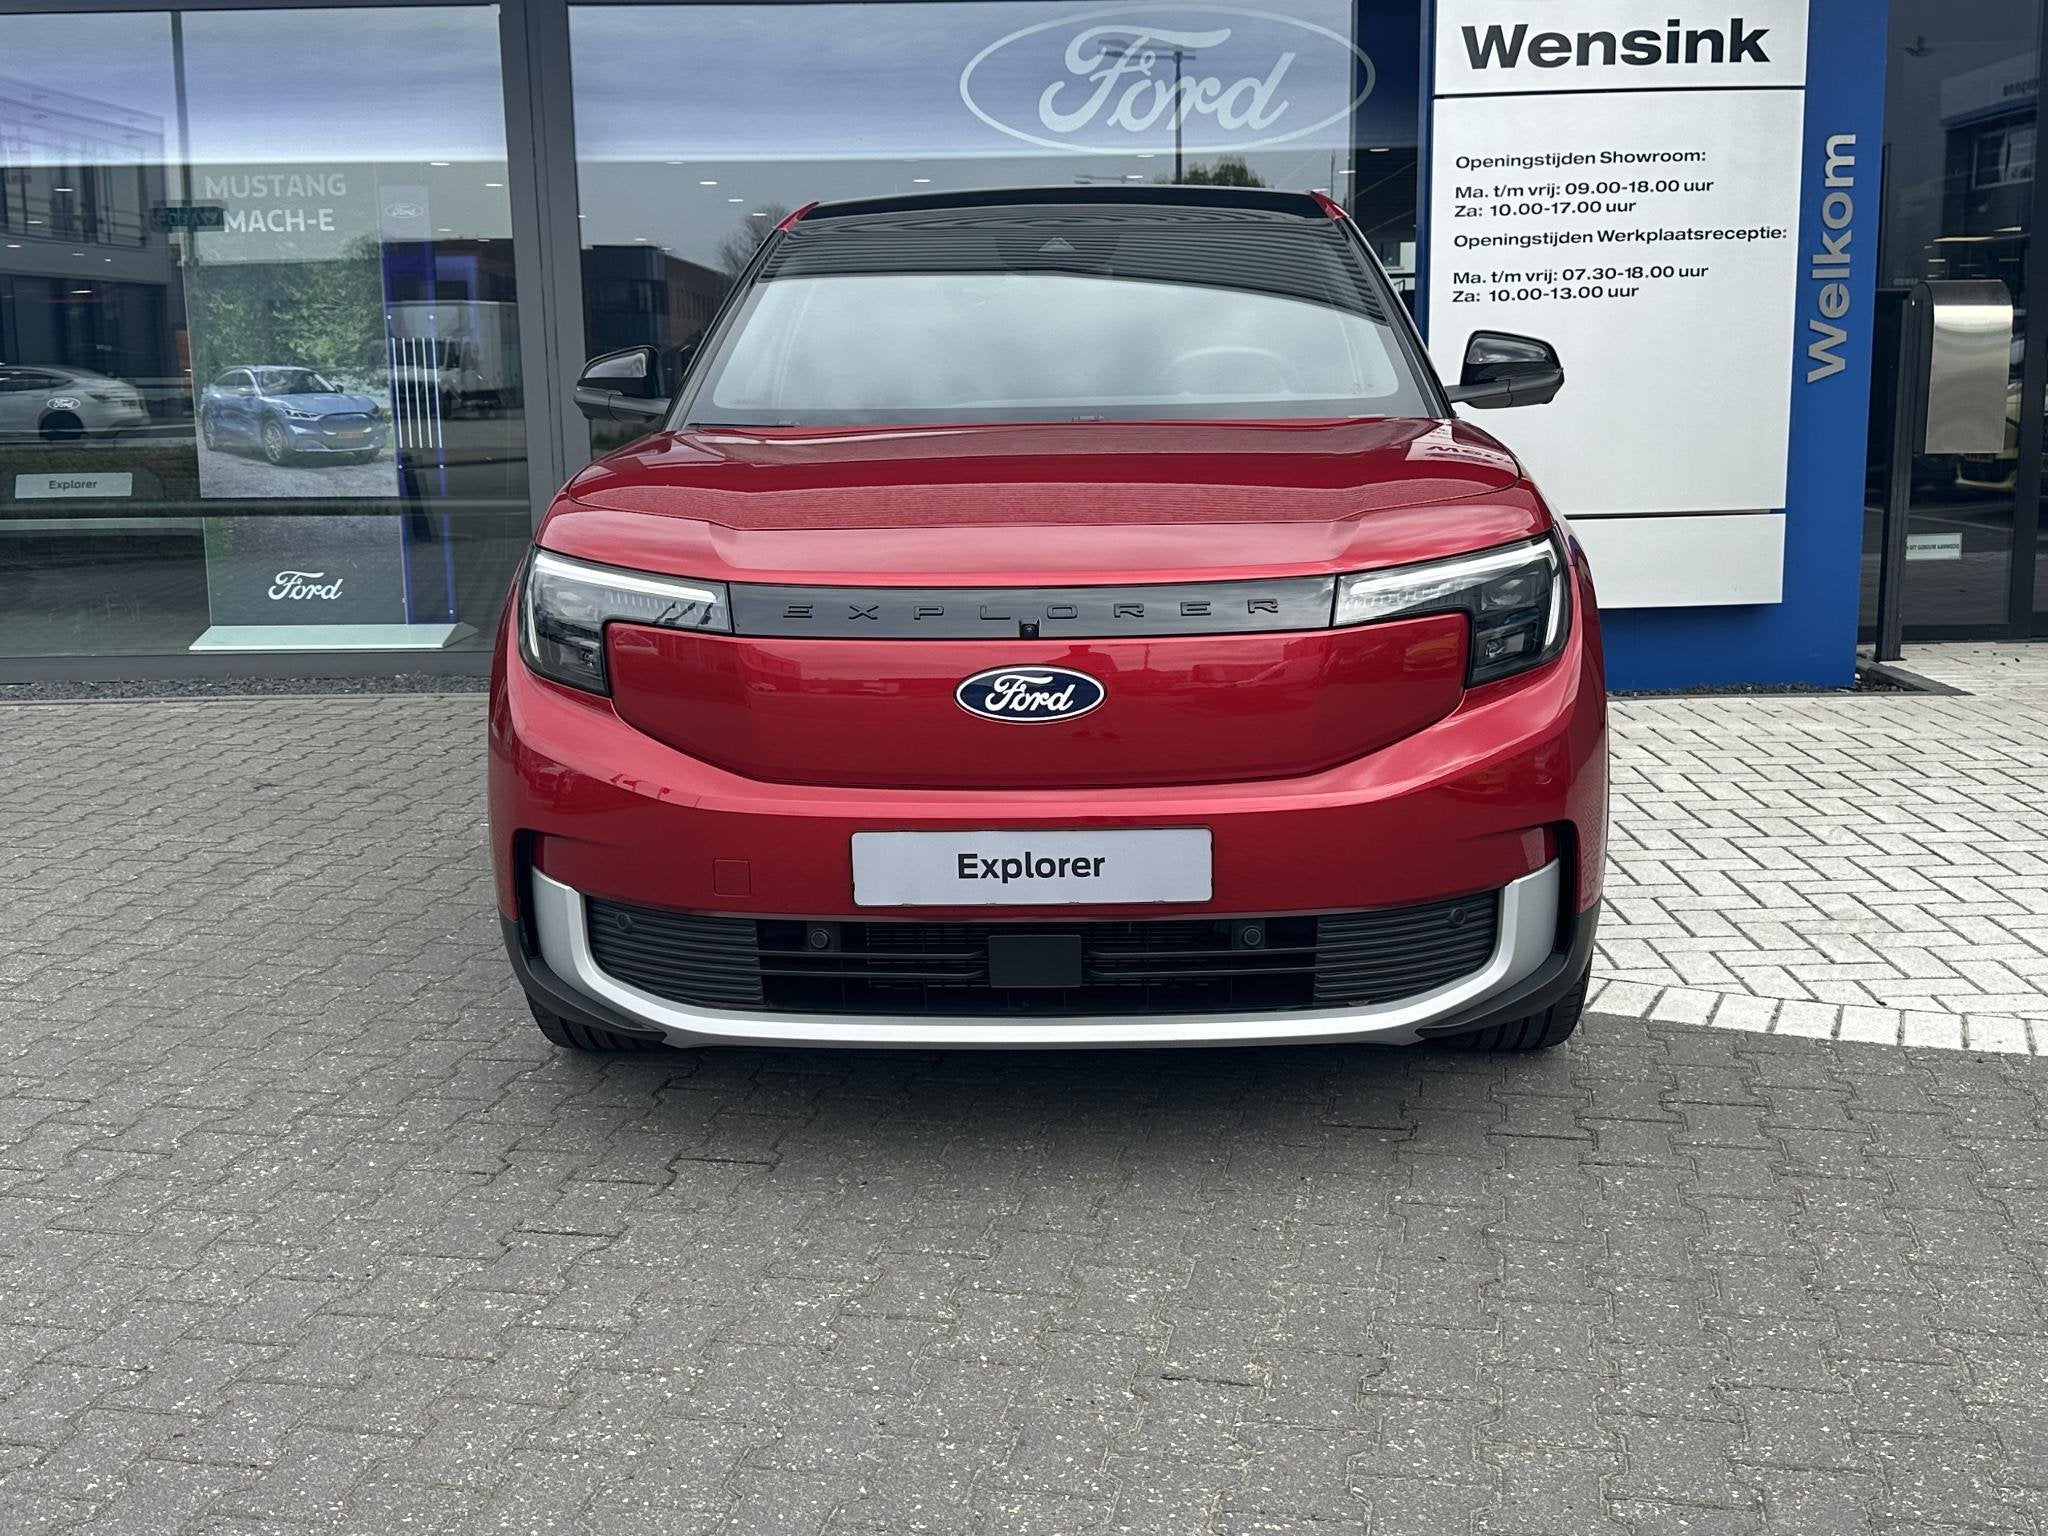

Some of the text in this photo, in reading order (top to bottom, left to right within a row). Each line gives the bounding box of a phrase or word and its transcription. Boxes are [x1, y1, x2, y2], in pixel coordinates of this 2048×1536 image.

[1462, 18, 1771, 70] Wensink
[1038, 24, 1296, 133] Ford
[1455, 150, 1706, 172] Openingstijden Showroom:
[204, 173, 347, 199] MUSTANG
[1455, 179, 1715, 199] Ma. t/m vrij: 09.00-18.00 uur
[223, 208, 335, 233] MACH-E
[1454, 200, 1637, 218] Za: 10.00-17.00 uur
[1453, 227, 1787, 250] Openingstijden Werkplaatsreceptie:
[1807, 133, 1857, 383] Welkom
[1453, 265, 1709, 285] Ma. t/m vrij: 07.30-18.00 uur
[1452, 285, 1640, 303] Za: 10.00-13.00 uur
[48, 479, 98, 491] Explorer
[268, 570, 344, 601] Ford
[783, 598, 1279, 620] EXPLORER
[984, 674, 1076, 712] Ford
[957, 851, 1106, 884] Explorer
